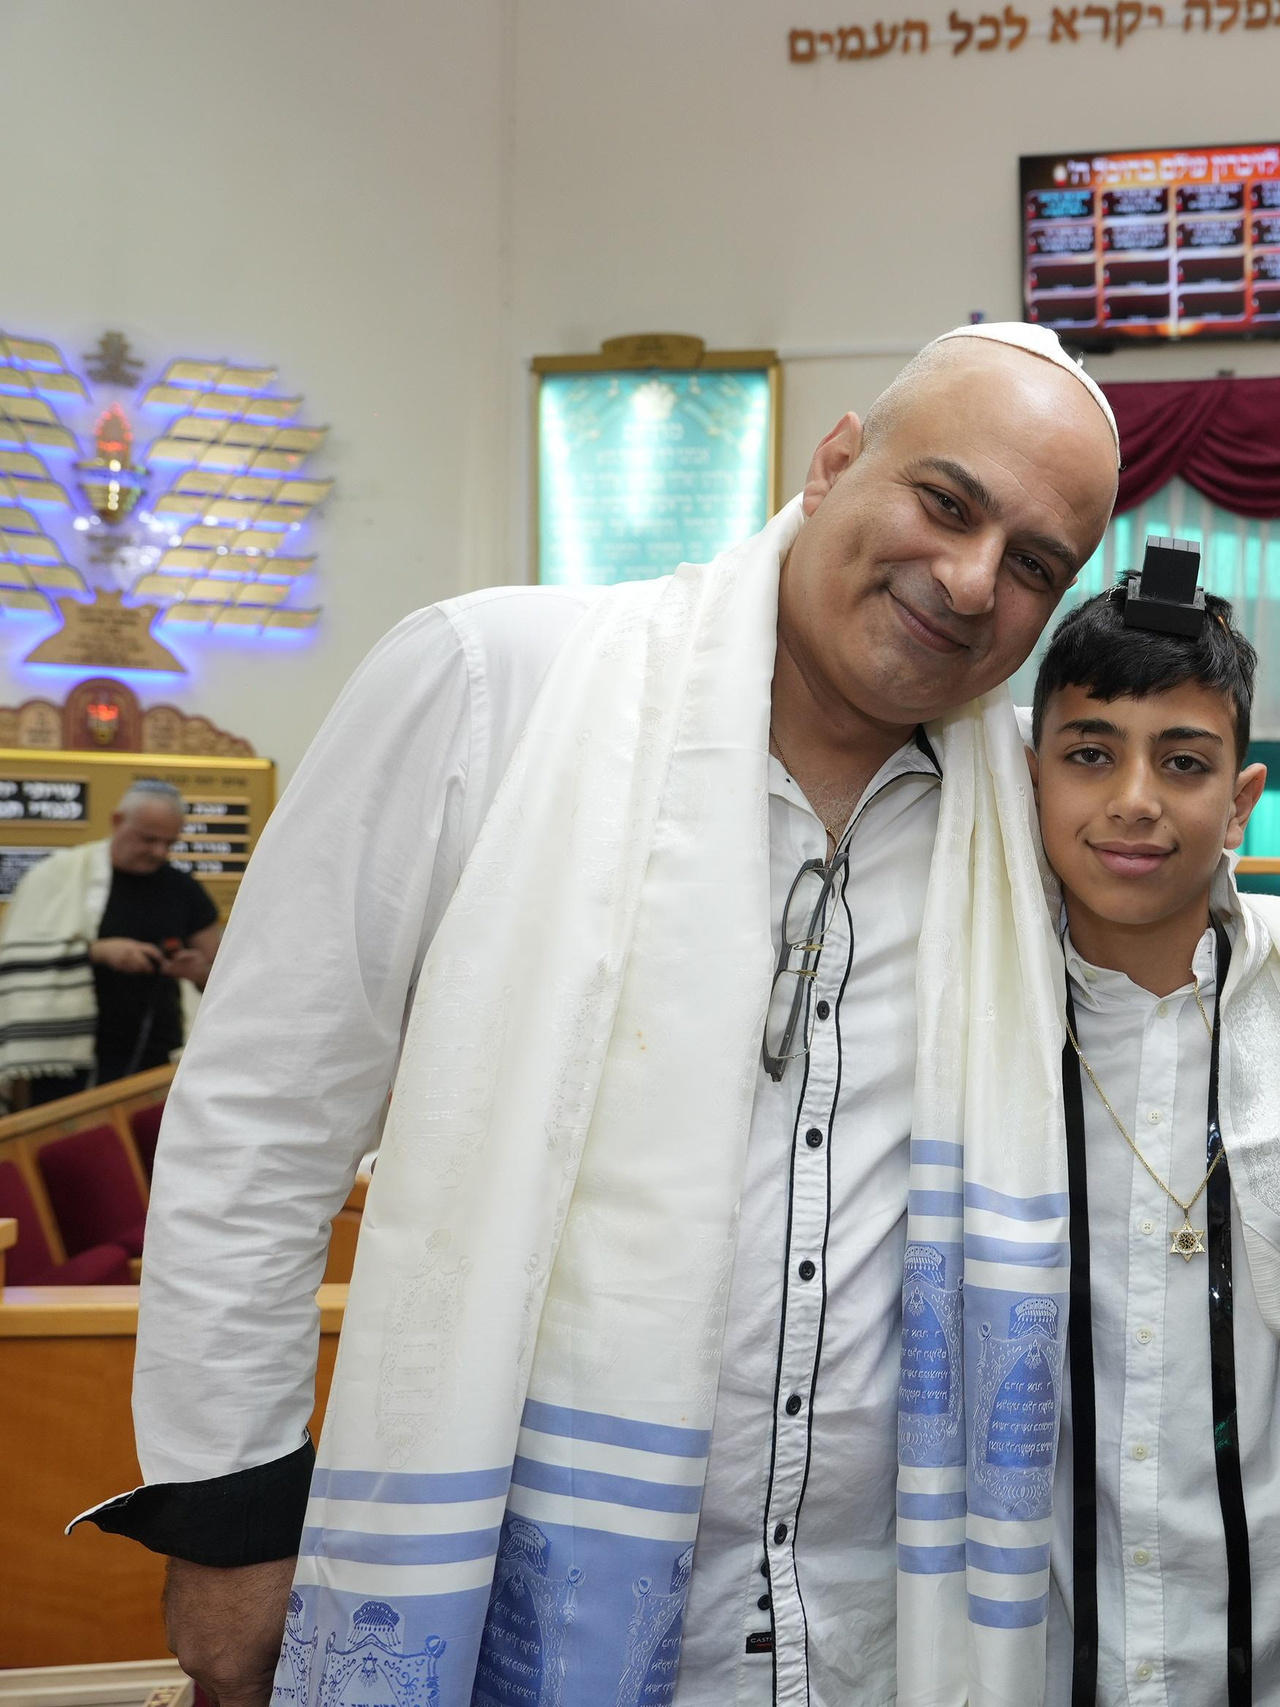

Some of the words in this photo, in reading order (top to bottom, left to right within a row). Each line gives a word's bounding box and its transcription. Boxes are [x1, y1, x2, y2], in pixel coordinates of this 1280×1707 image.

[789, 18, 928, 64] העמים
[949, 4, 1028, 56] לכל
[1049, 1, 1164, 48] יקרא
